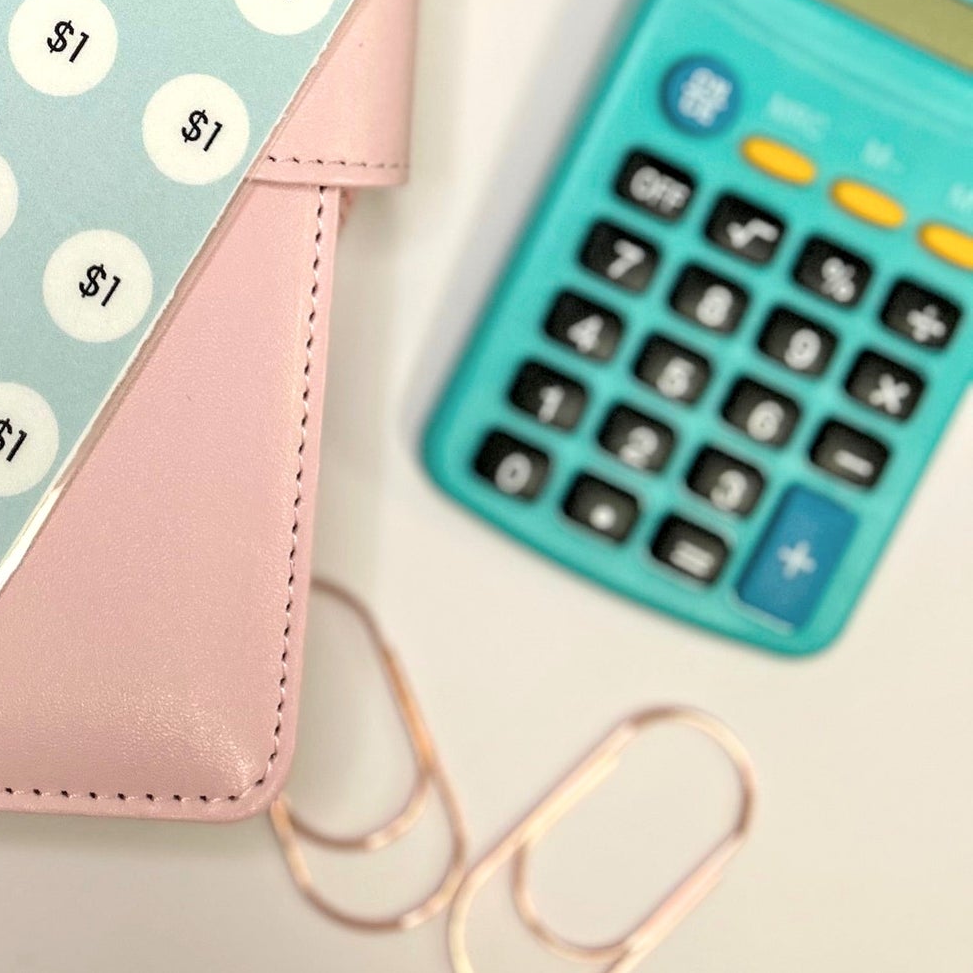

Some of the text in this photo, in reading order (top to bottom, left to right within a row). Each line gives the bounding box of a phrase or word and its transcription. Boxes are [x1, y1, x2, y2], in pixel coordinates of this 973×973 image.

[46, 19, 90, 64] $1
[181, 109, 223, 152] $1
[606, 239, 645, 280] 7
[78, 263, 121, 307] $1
[695, 284, 734, 328] 8
[568, 315, 605, 353] 4
[783, 328, 822, 371] 9
[538, 385, 567, 423] 1
[618, 426, 660, 469] 2
[494, 452, 533, 494] 0
[709, 468, 749, 512] 3
